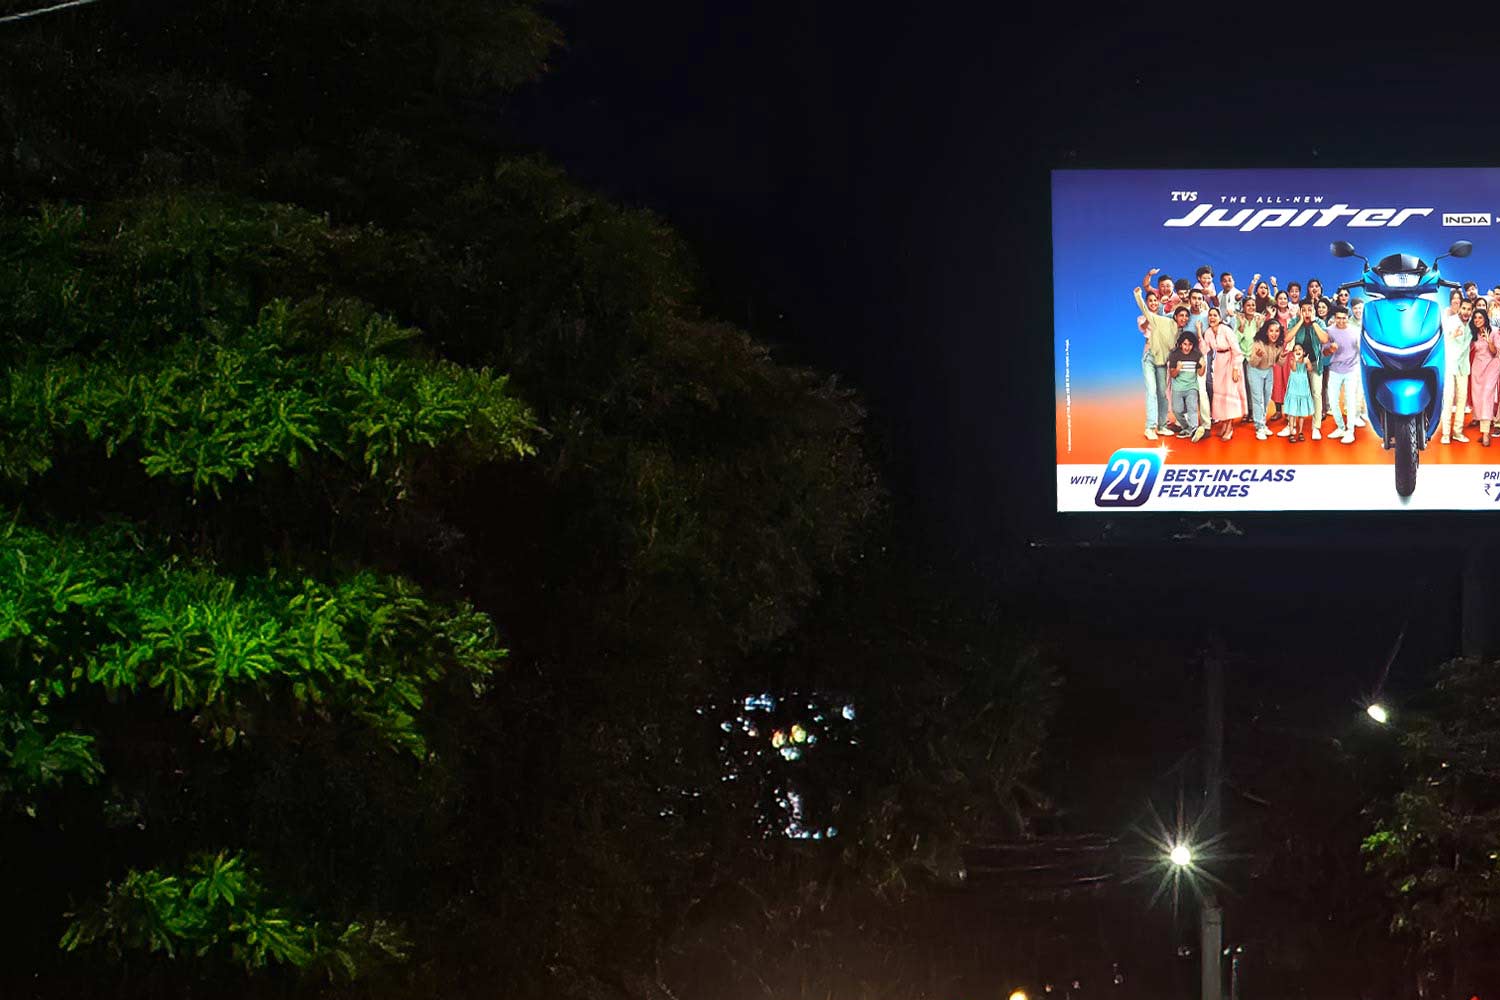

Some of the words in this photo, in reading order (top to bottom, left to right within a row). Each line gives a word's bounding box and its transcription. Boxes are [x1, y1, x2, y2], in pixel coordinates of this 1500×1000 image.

[1170, 191, 1198, 202] TVS
[1220, 196, 1247, 204] THE
[1256, 195, 1324, 204] ALL-NEW
[1445, 215, 1488, 225] INDIA
[1070, 475, 1098, 485] WITH
[1100, 458, 1152, 501] 29
[1162, 469, 1296, 482] BEST-IN-CLASS
[1157, 484, 1251, 498] FEATURES
